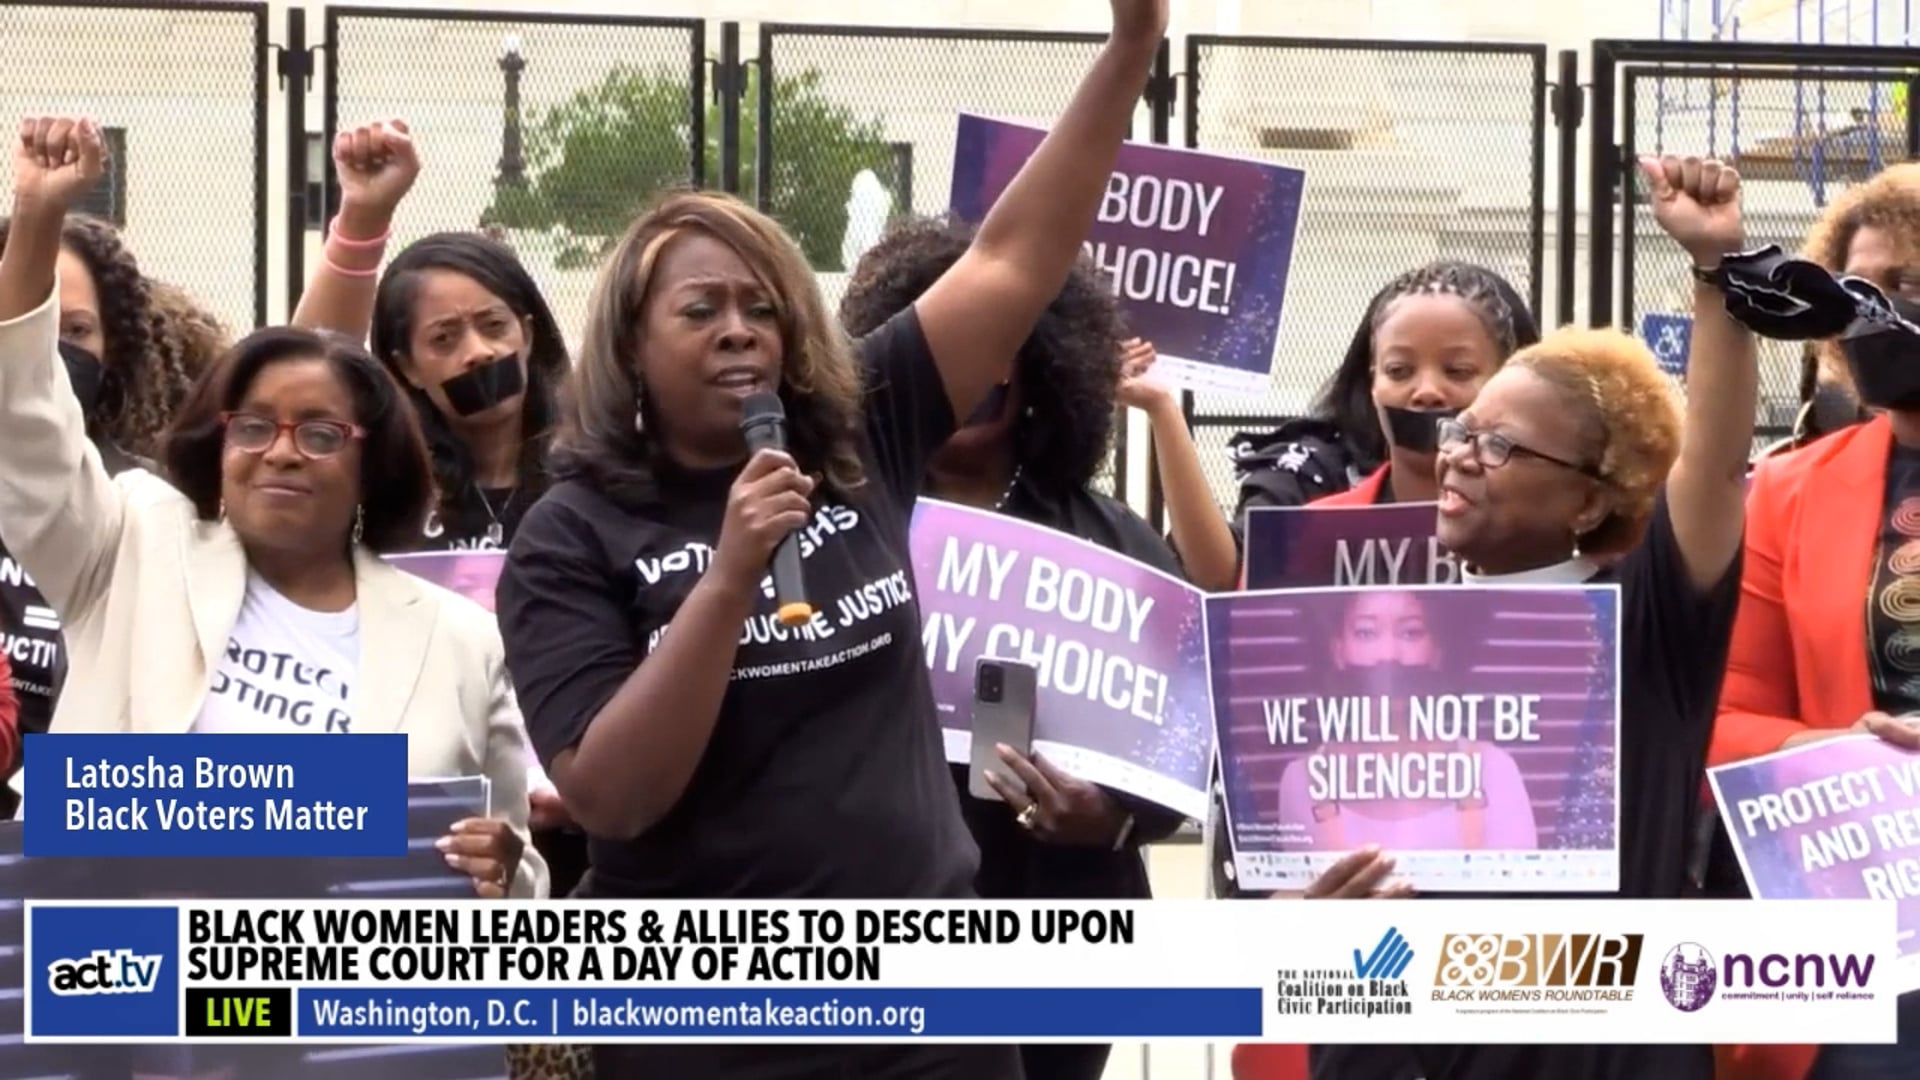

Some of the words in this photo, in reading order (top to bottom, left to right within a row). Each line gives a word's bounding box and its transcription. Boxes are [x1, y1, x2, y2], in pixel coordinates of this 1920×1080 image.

[1097, 171, 1225, 236] BODY
[937, 536, 1019, 600] MY
[1025, 556, 1154, 643] BODY
[1333, 537, 1411, 585] MY
[985, 624, 1169, 725] CHOICE!
[1263, 698, 1308, 745] WE
[1316, 696, 1399, 743] WILL
[1410, 694, 1484, 742] NOT
[1494, 695, 1541, 742] BE
[1308, 753, 1483, 800] SILENCED!
[1738, 767, 1886, 838] PROTECT
[1800, 821, 1871, 873] AND
